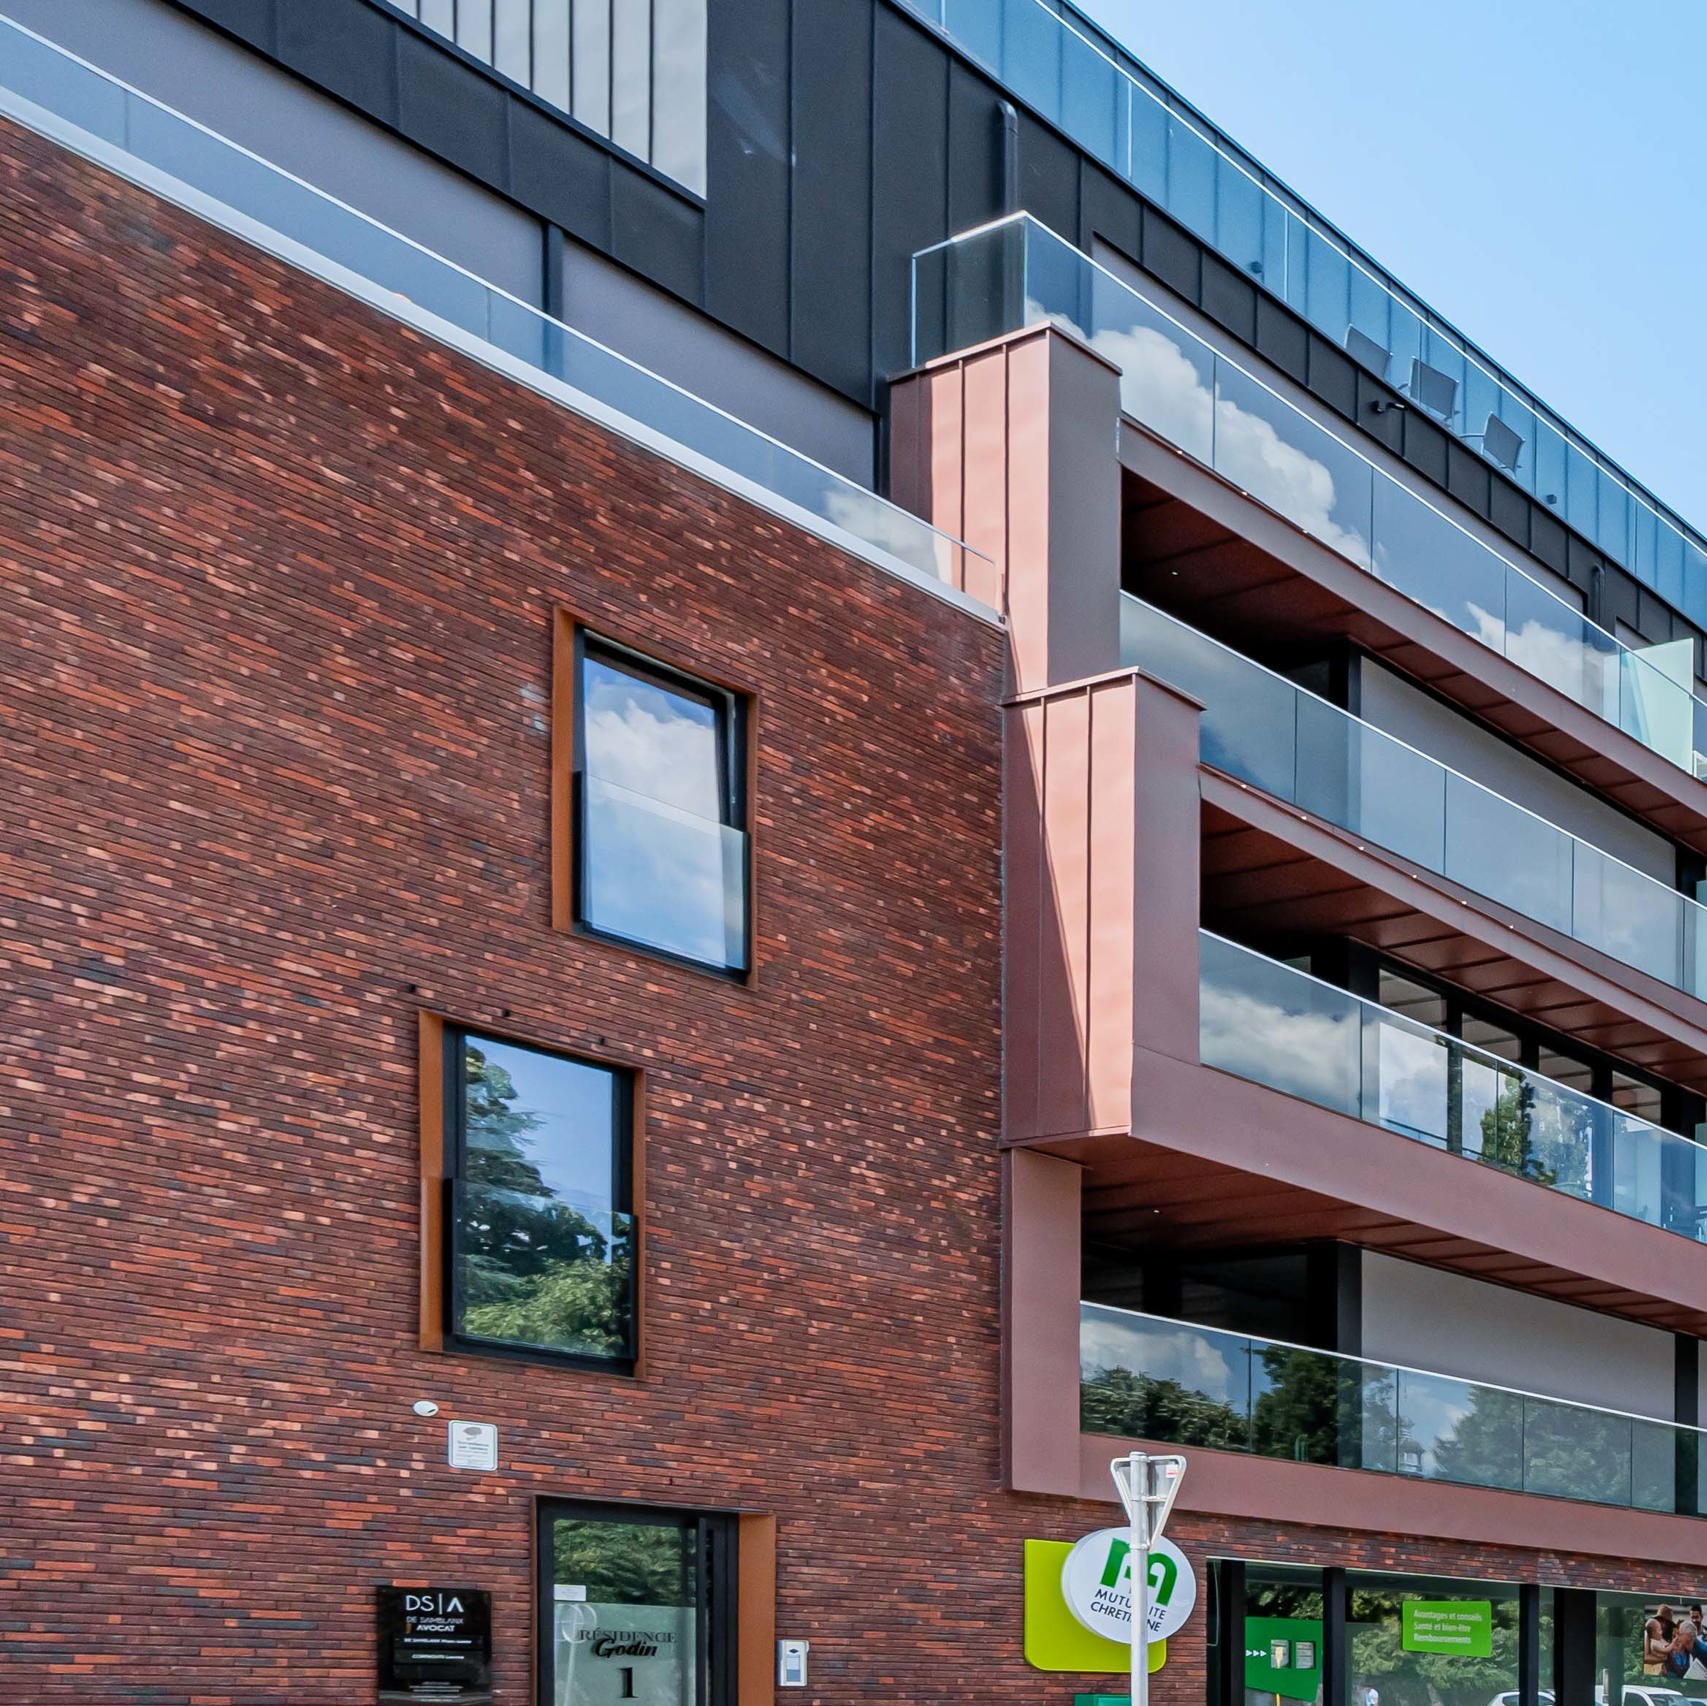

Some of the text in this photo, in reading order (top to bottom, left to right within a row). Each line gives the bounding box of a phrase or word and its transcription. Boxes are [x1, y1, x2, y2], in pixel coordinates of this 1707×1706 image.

[1090, 1601, 1162, 1632] CHRETINE
[1094, 1588, 1167, 1620] MUTUITE
[593, 1638, 658, 1658] Godin
[618, 1666, 640, 1699] 1
